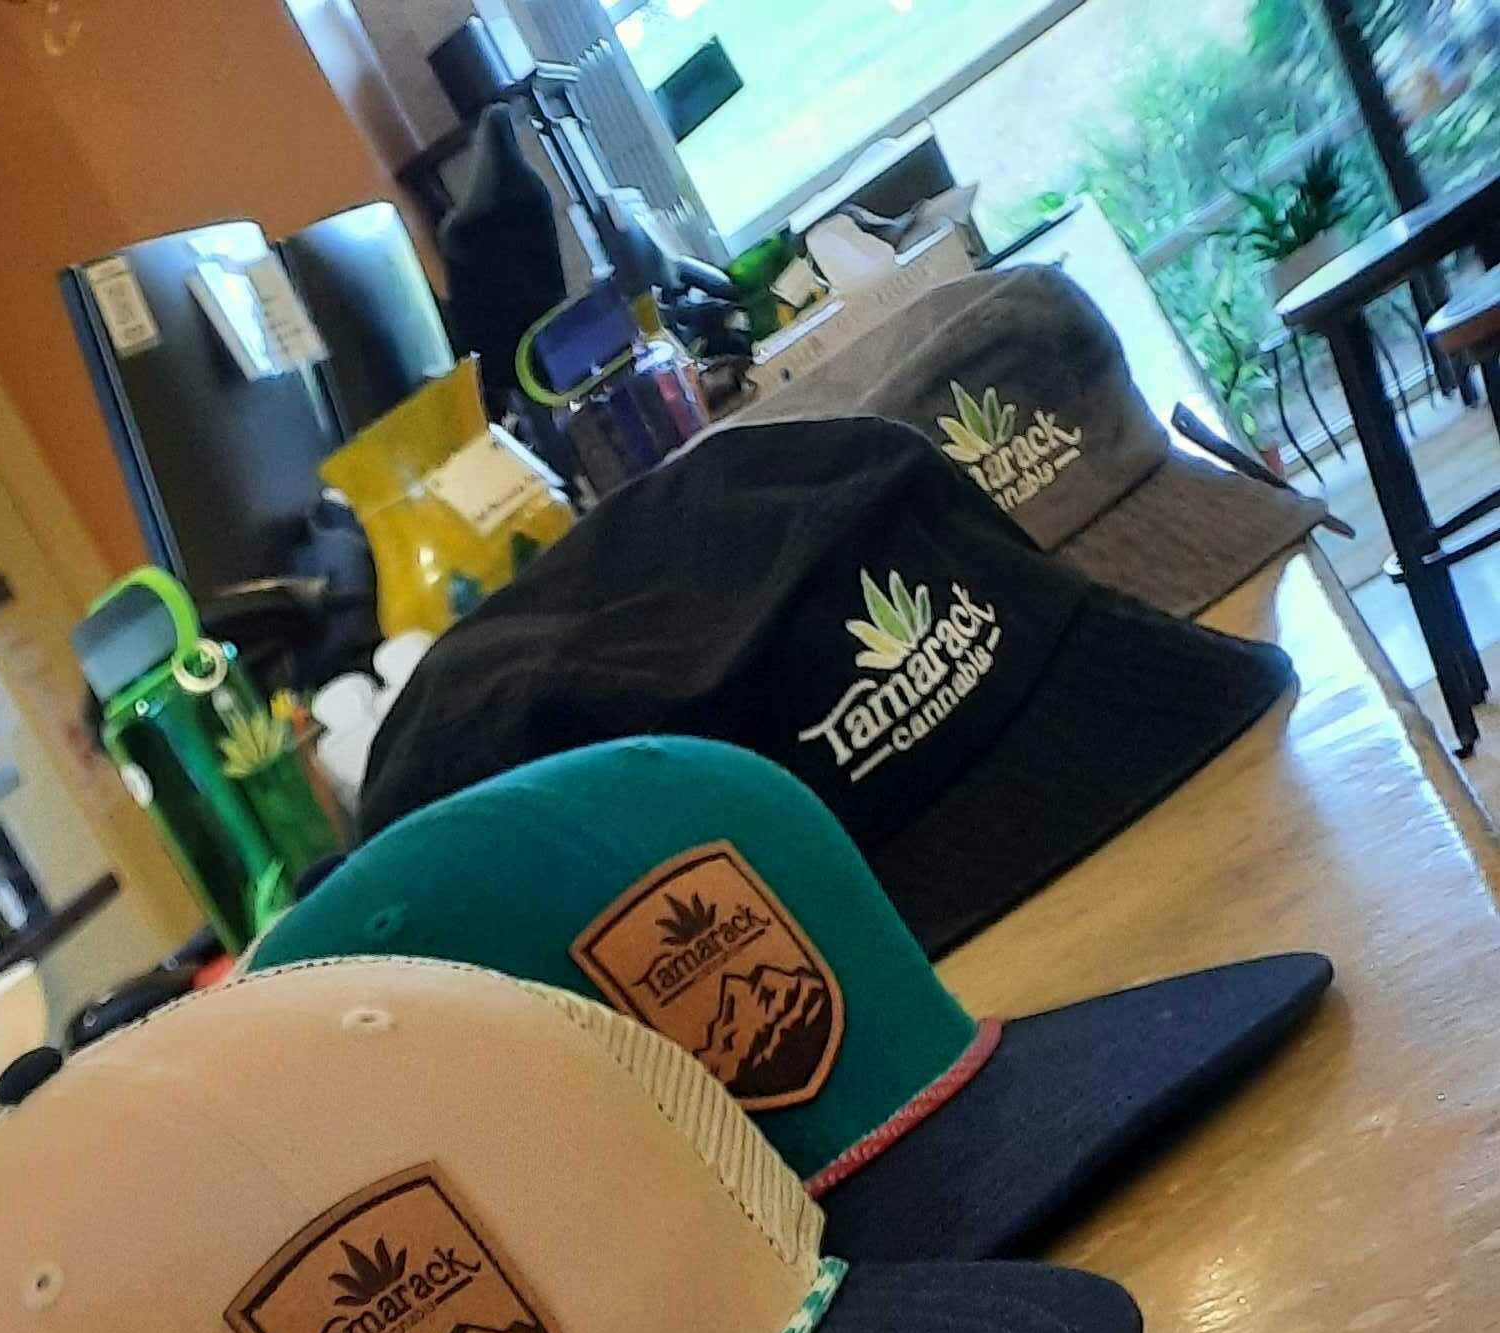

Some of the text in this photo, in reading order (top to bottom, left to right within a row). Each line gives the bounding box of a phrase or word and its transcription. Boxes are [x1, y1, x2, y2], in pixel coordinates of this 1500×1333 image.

[798, 582, 996, 767] Tamarack
[892, 645, 994, 752] cannabis
[630, 902, 772, 999] Tamarack
